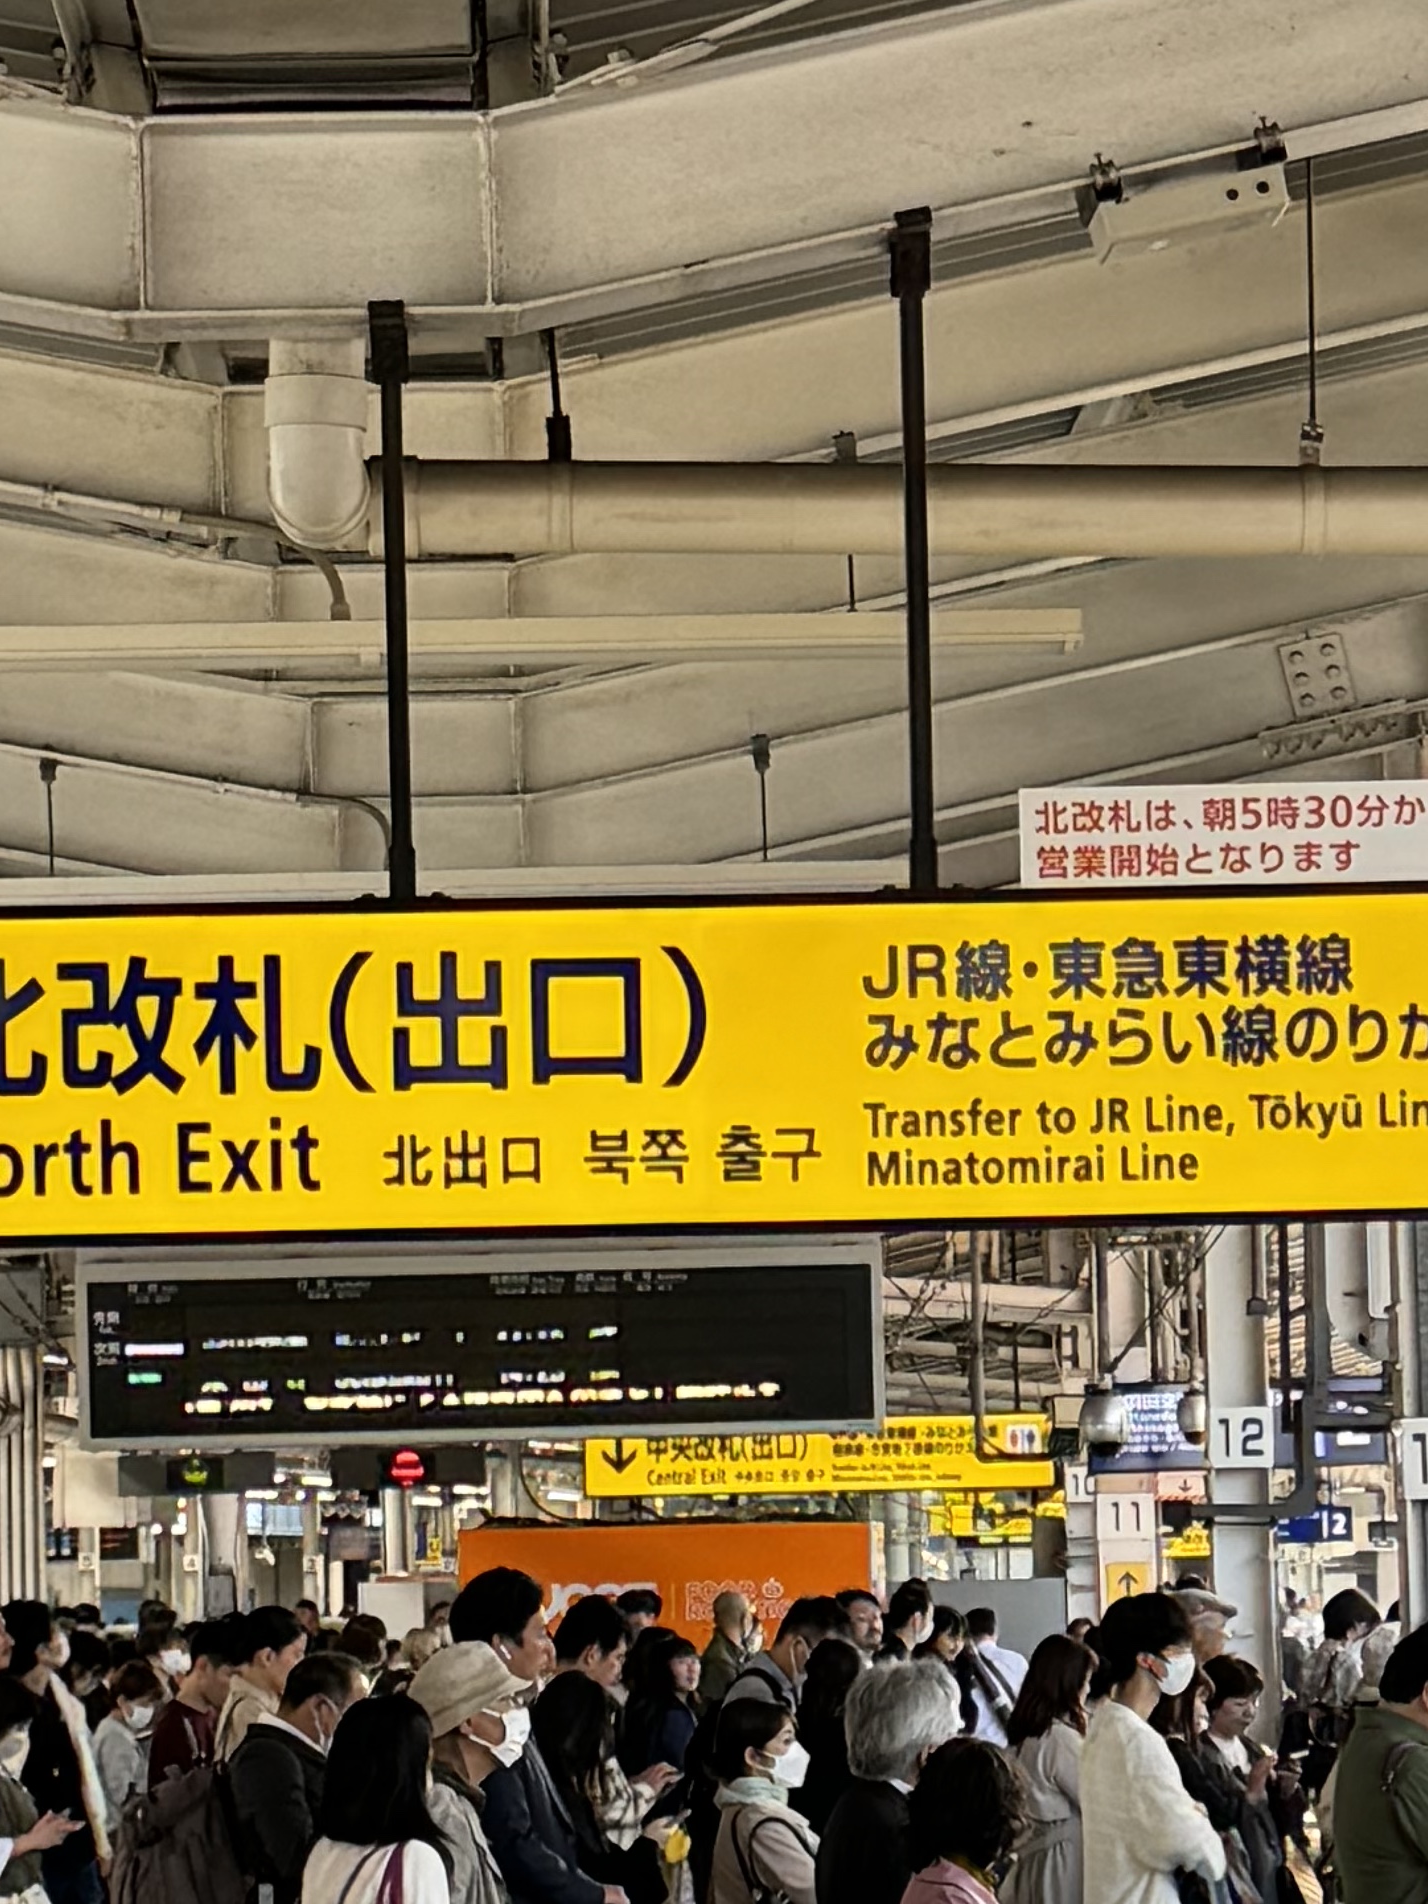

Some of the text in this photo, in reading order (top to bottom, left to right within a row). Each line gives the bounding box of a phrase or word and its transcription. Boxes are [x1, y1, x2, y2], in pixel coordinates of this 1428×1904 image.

[1035, 840, 1362, 879] 営業開始となります
[862, 932, 1353, 1002] JR線・東急東横線
[862, 1097, 1022, 1138] Transfer
[1036, 1101, 1076, 1135] to
[1090, 1097, 1130, 1134] JR
[1145, 1094, 1235, 1137] Line,
[1248, 1090, 1362, 1139] Tōkyū
[177, 1116, 321, 1193] Exit
[383, 1129, 541, 1189] 北出口
[583, 1124, 822, 1185] 북쪽 출구
[867, 1142, 1199, 1187] Minatomirai Line
[1218, 1417, 1265, 1458] 12
[647, 1467, 726, 1486] Central Exit
[1112, 1501, 1141, 1532] 11
